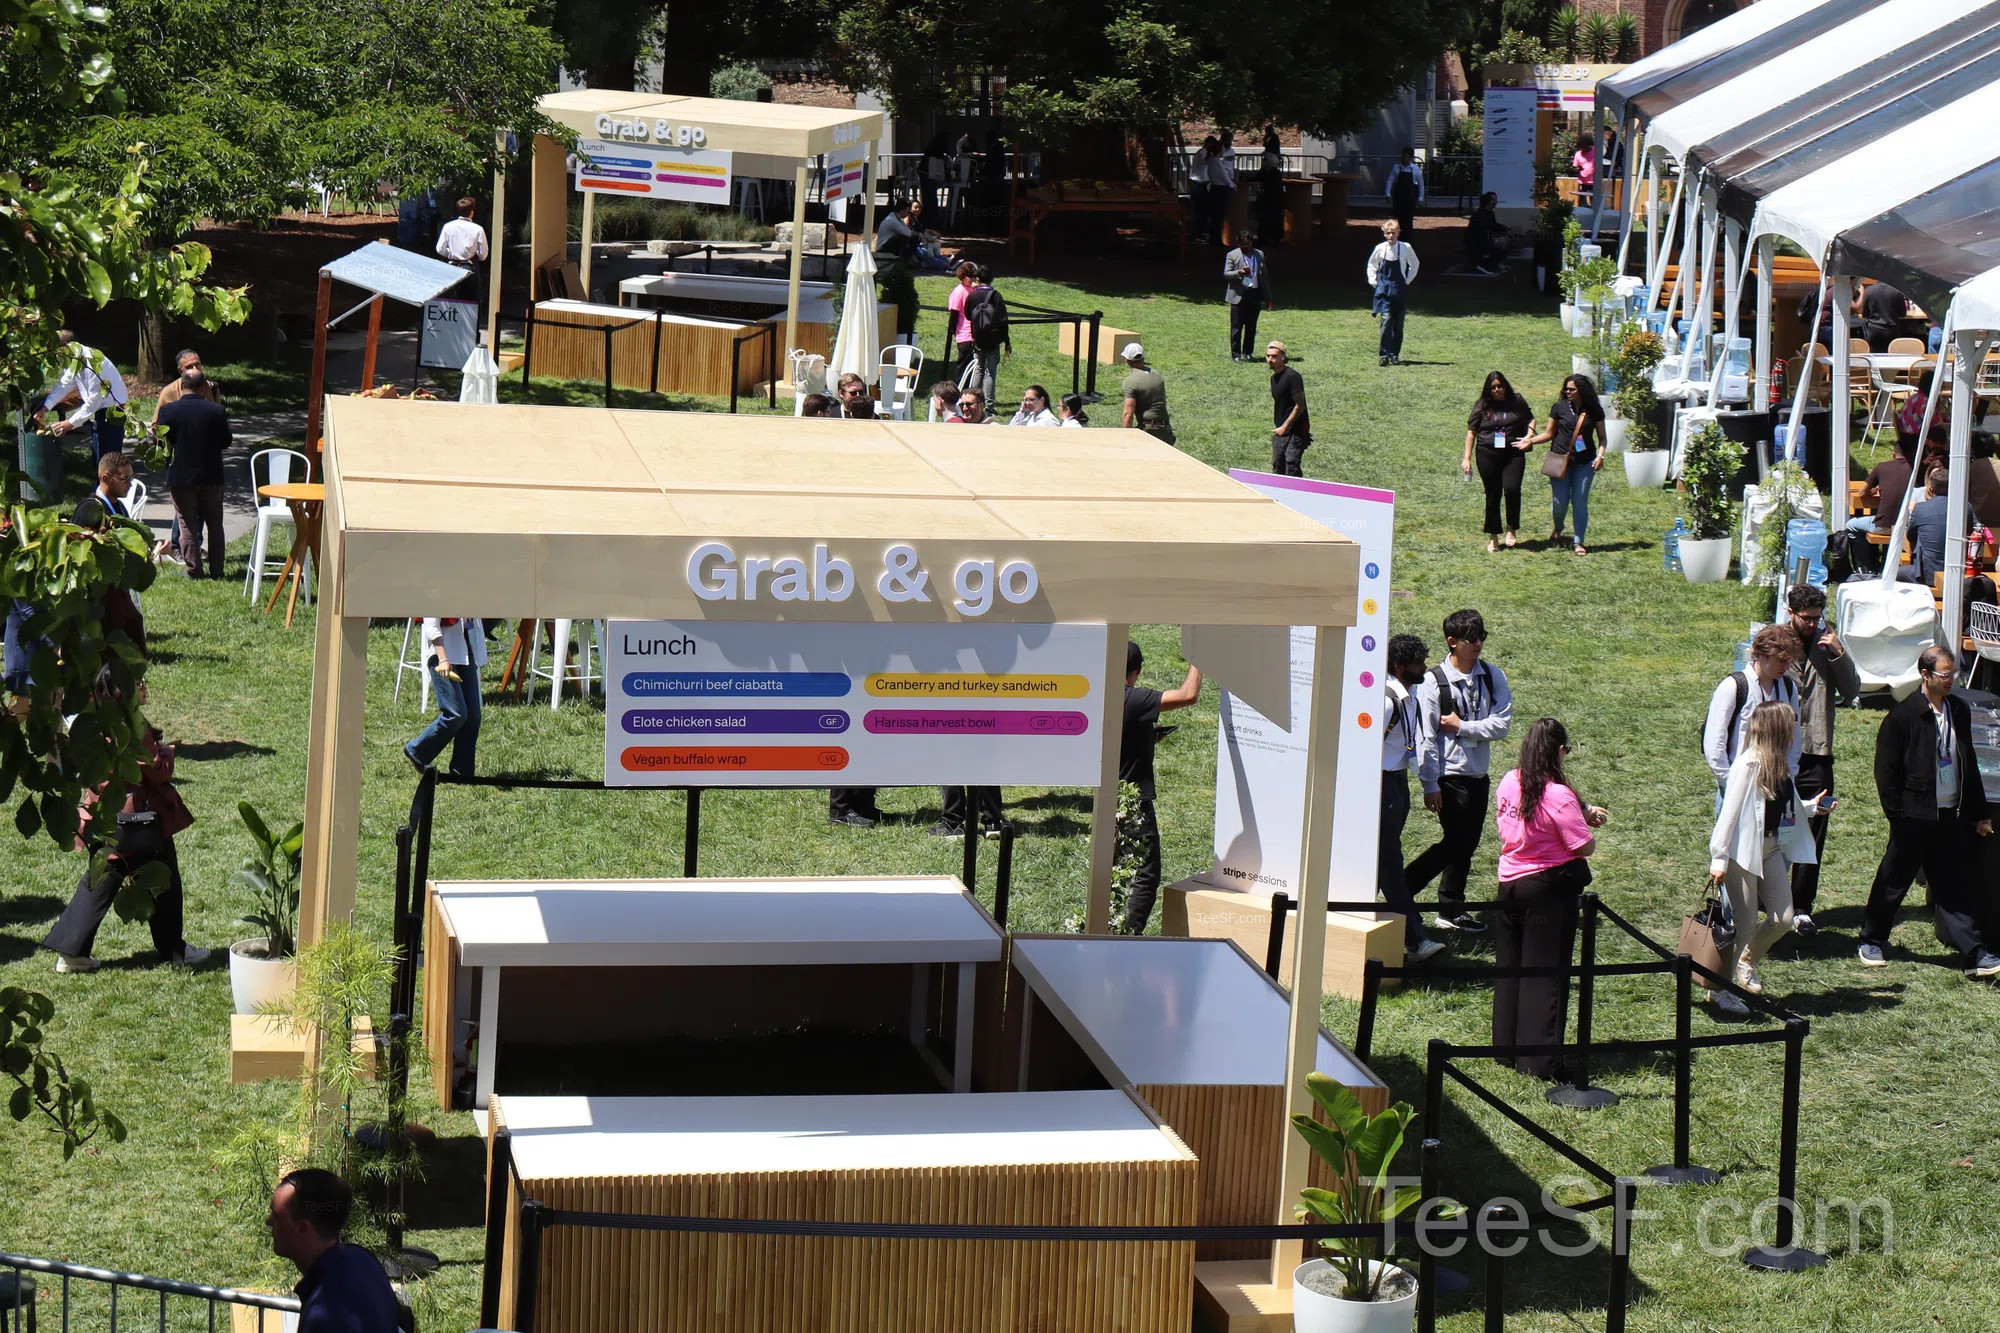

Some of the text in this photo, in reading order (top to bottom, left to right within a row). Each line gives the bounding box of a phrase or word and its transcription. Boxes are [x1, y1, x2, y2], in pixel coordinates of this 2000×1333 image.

[1575, 67, 1589, 80] go
[594, 113, 706, 146] Grab & go
[582, 143, 605, 152] Lunch
[428, 305, 459, 322] Exit
[687, 543, 1039, 616] Grab & go
[623, 635, 696, 656] Lunch
[633, 678, 784, 690] Chimichurri beef ciabatta
[875, 679, 1058, 693] Cranberry and turkey sandwich
[633, 716, 747, 728] Elote chicken salad
[825, 718, 837, 726] GF
[875, 716, 996, 729] Harissa harvest bowl
[1036, 719, 1048, 727] GF
[1066, 719, 1073, 727] V
[1228, 723, 1263, 737] Soft drinks
[633, 754, 747, 767] Vegan buffalo wrap
[825, 755, 837, 763] VG
[1223, 867, 1288, 887] stripe sessions
